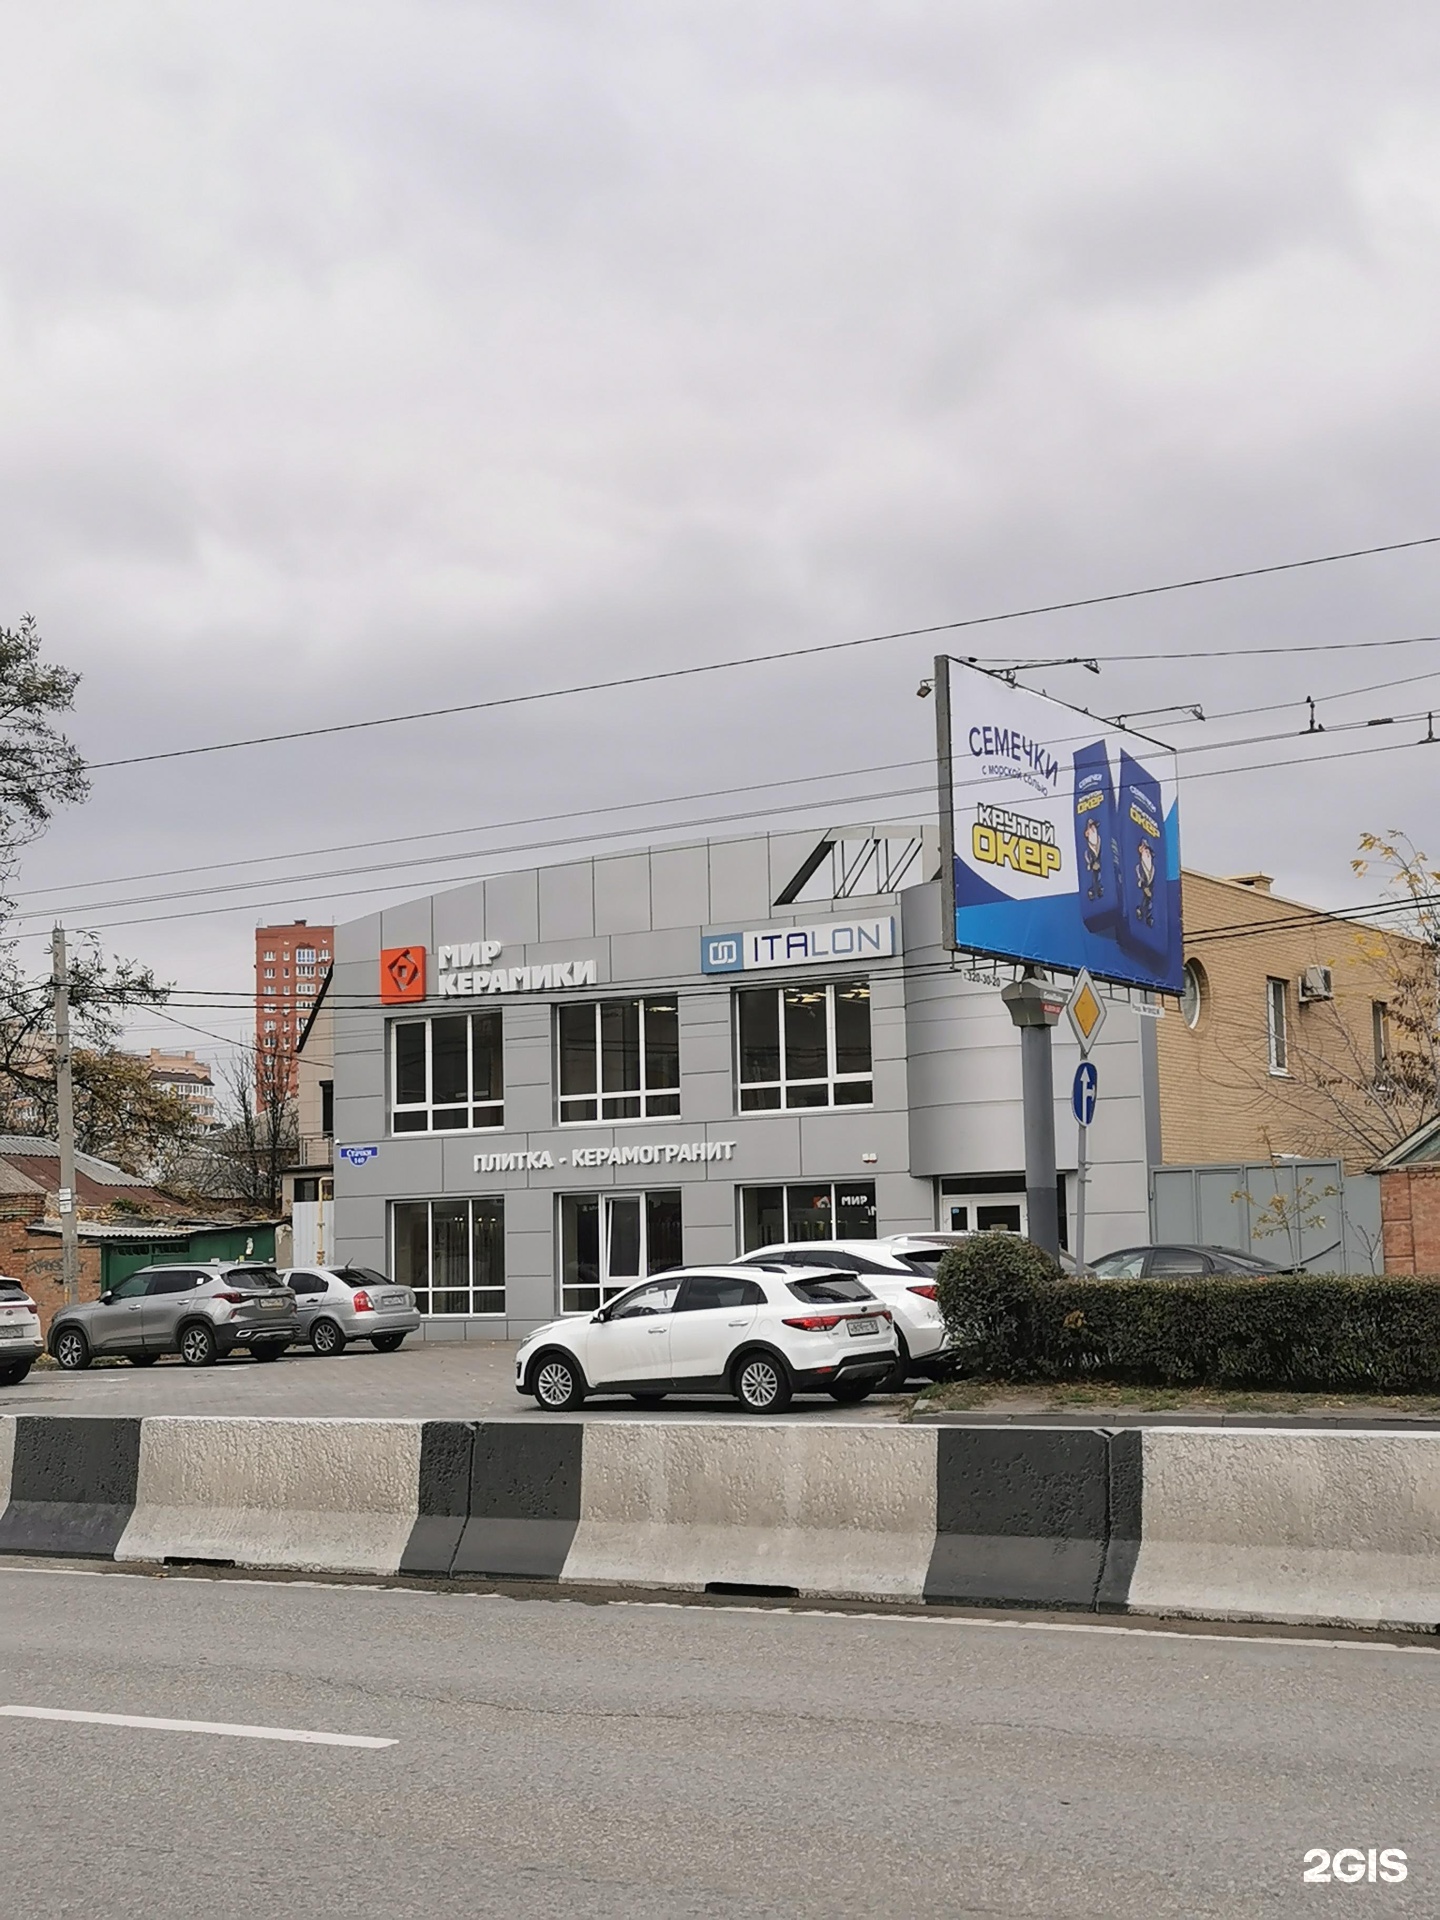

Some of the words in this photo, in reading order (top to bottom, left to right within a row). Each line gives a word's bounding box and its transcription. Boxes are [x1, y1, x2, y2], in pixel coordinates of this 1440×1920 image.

[969, 726, 1058, 787] СЕМЕЧКИ
[977, 802, 1055, 844] КРУТОЙ
[438, 941, 501, 970] МИР
[754, 924, 880, 962] ITALON
[438, 960, 597, 996] КЕРАМИКИ
[473, 1150, 554, 1173] ПЛИТКА
[572, 1141, 736, 1168] КЕРАМОГРАНИТ
[841, 1195, 868, 1206] МИР
